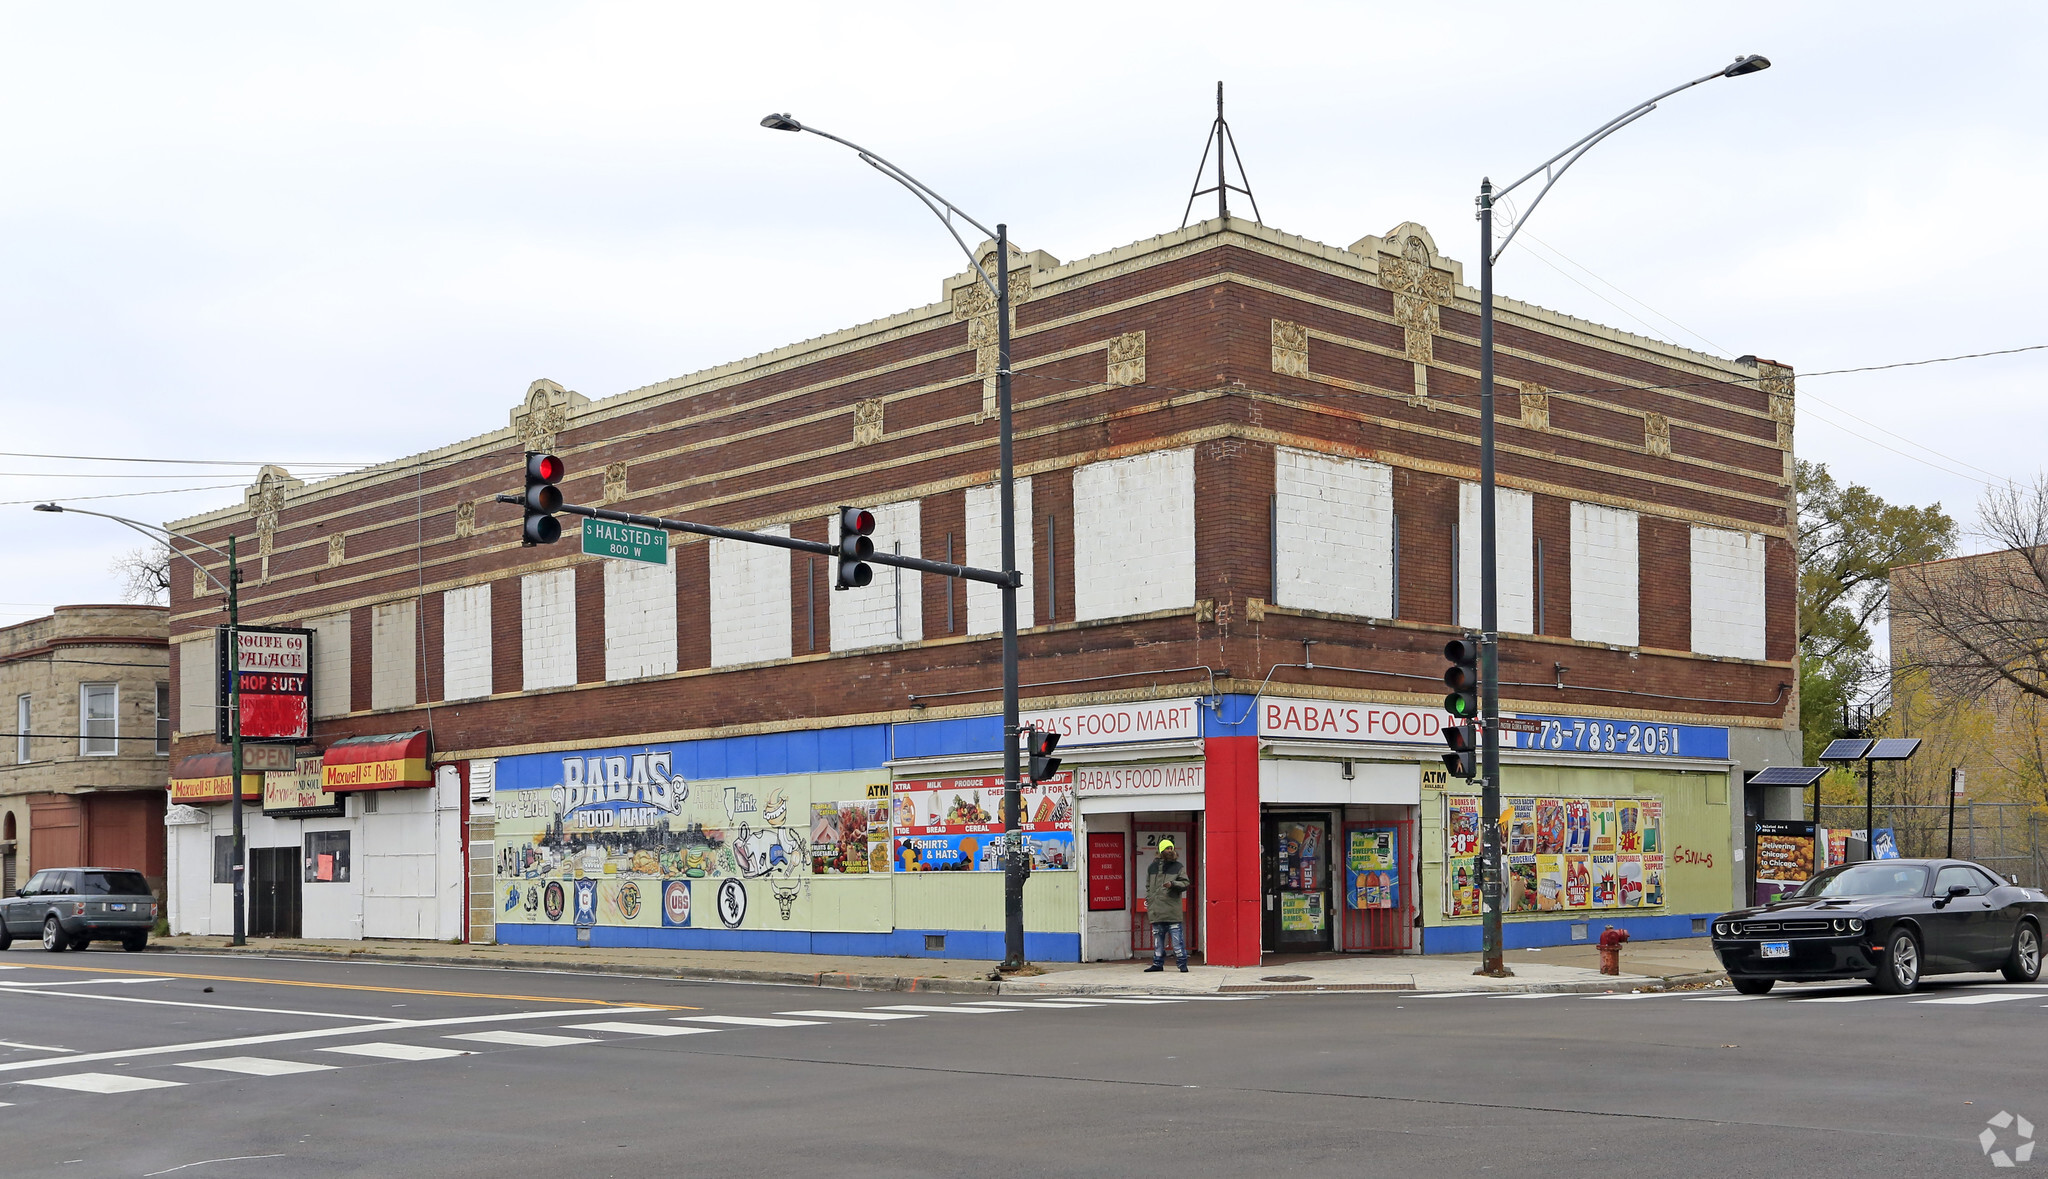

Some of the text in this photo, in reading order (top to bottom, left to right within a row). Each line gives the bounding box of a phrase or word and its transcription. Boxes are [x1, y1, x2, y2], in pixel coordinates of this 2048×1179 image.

[586, 524, 664, 546] S HALSTED ST
[609, 543, 642, 557] 800 W
[286, 638, 303, 651] 69
[240, 675, 304, 692] HOP SUEY
[1018, 707, 1192, 740] ABA'S FOOD MART
[1267, 704, 1360, 734] BABA'S
[1368, 710, 1440, 737] FOOD
[243, 747, 289, 767] OPEN
[328, 765, 362, 785] Maxwell
[376, 763, 398, 782] Polish
[1080, 766, 1203, 791] BABA'S FOOD MART
[1423, 771, 1447, 784] ATM
[175, 780, 204, 797] Maxwell
[213, 778, 232, 795] Polish
[867, 785, 888, 797] ATM
[894, 782, 911, 791] XTRA
[926, 781, 942, 790] MILK
[954, 778, 984, 788] PRODUCE
[1048, 785, 1063, 794] FOR
[735, 793, 757, 813] Link
[1460, 805, 1476, 813] CEREAL
[495, 801, 550, 820] 783-2051
[578, 807, 658, 828] FOOD MART
[896, 827, 910, 835] TIDE
[926, 826, 947, 834] BREAD
[965, 824, 990, 833] CEREAL
[1054, 821, 1073, 830] POPS
[910, 839, 948, 850] T-SHIRTS
[1761, 842, 1796, 851] Delivering
[926, 849, 959, 860] & HATS
[1509, 856, 1536, 864] GROCERIES
[1593, 855, 1614, 864] BLEACH
[1761, 850, 1789, 859] Chicago
[1769, 859, 1799, 868] Chicago.
